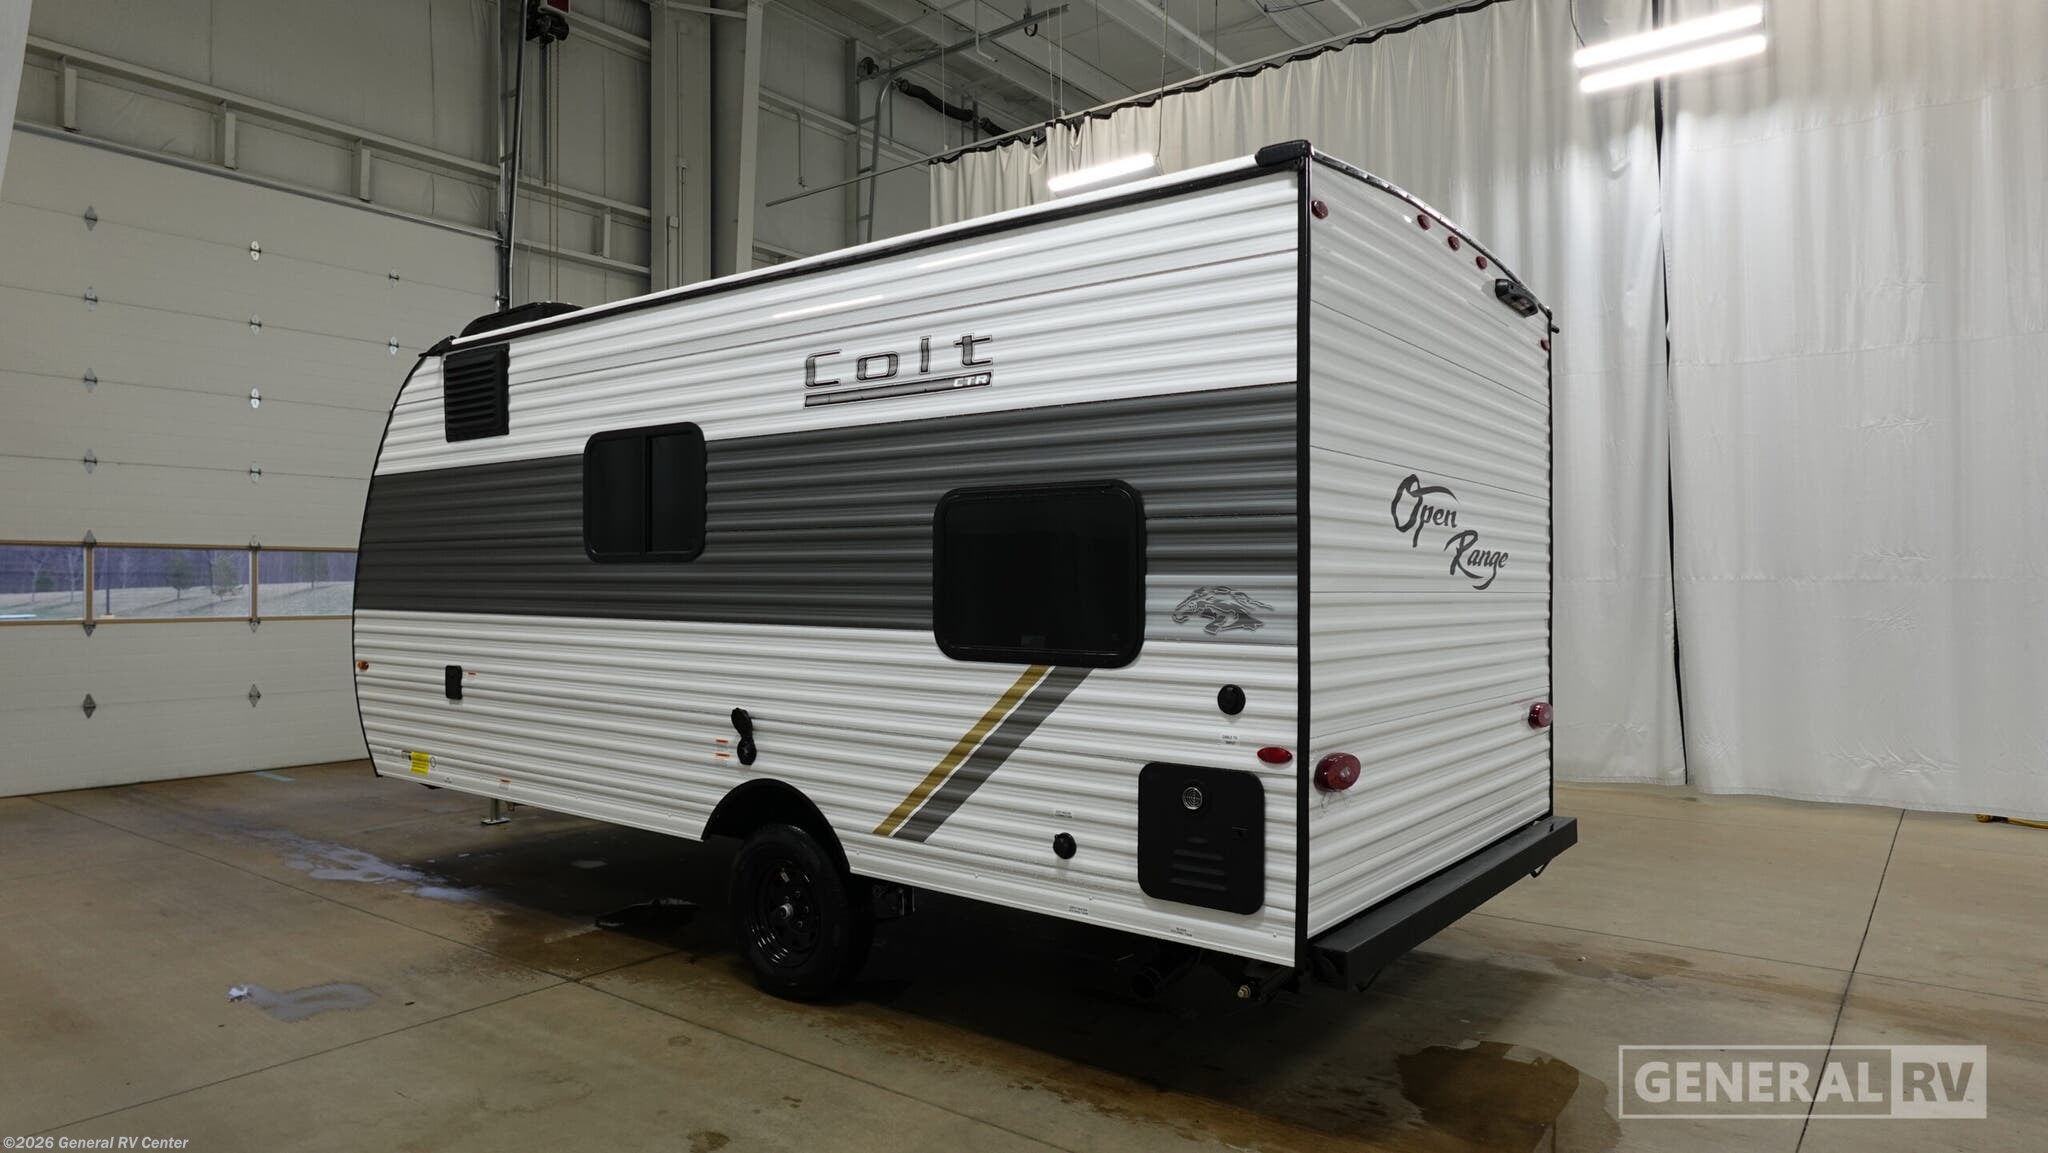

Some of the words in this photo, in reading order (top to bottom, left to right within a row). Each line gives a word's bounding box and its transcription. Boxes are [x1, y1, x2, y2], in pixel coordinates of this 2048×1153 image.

[804, 333, 993, 388] Colt
[952, 375, 990, 388] CTR
[1390, 473, 1460, 548] Open
[1443, 529, 1510, 591] Range
